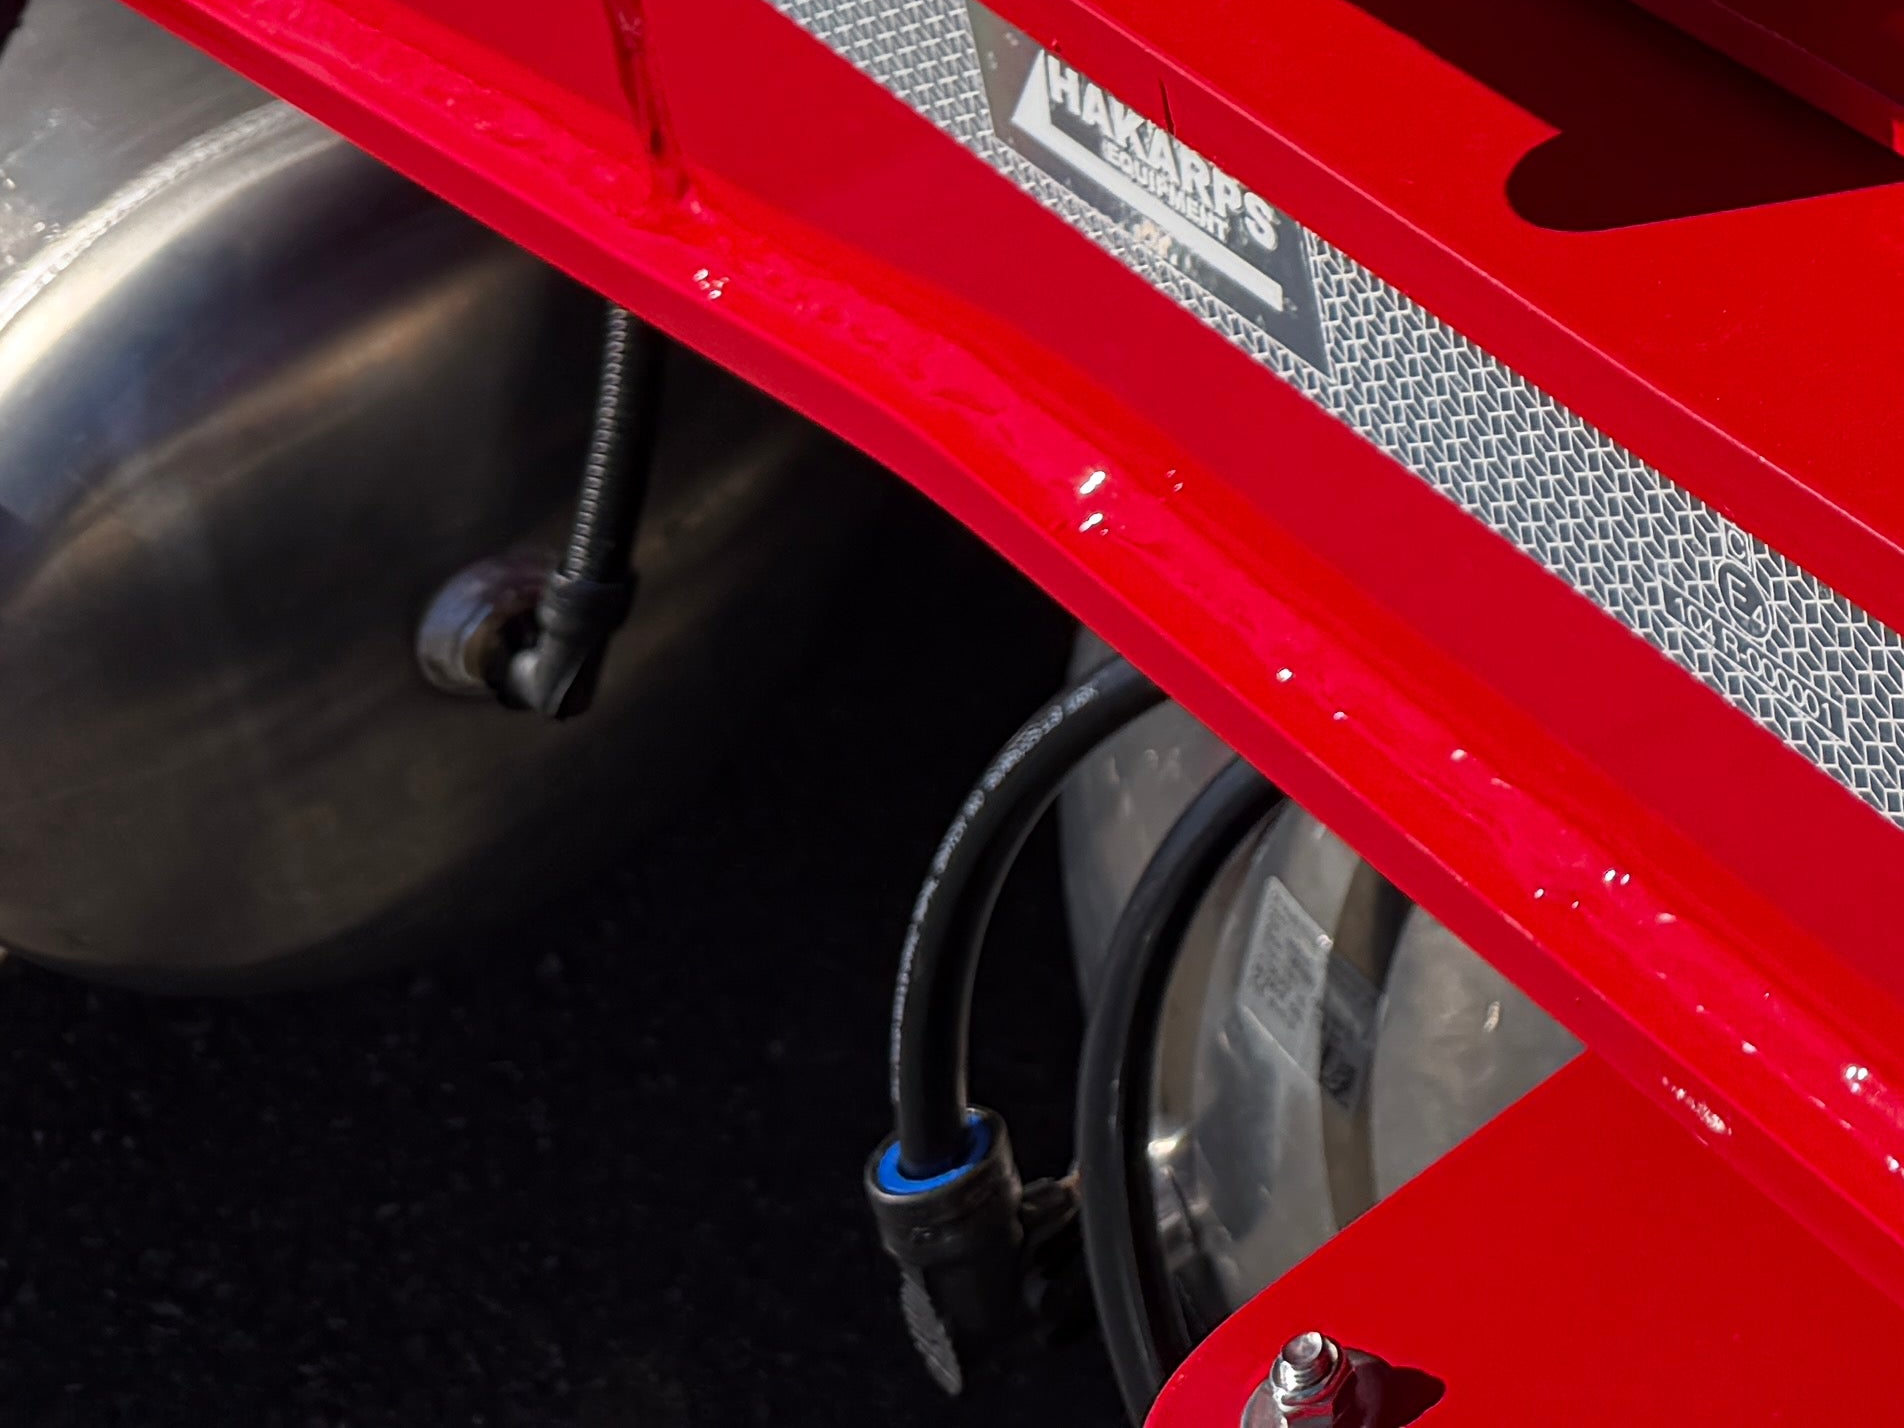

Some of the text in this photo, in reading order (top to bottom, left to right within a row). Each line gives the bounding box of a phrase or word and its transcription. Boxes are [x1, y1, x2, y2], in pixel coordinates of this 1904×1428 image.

[1047, 53, 1279, 251] HAKARPS
[1727, 529, 1746, 559] C
[1675, 597, 1833, 729] 104 R-000001
